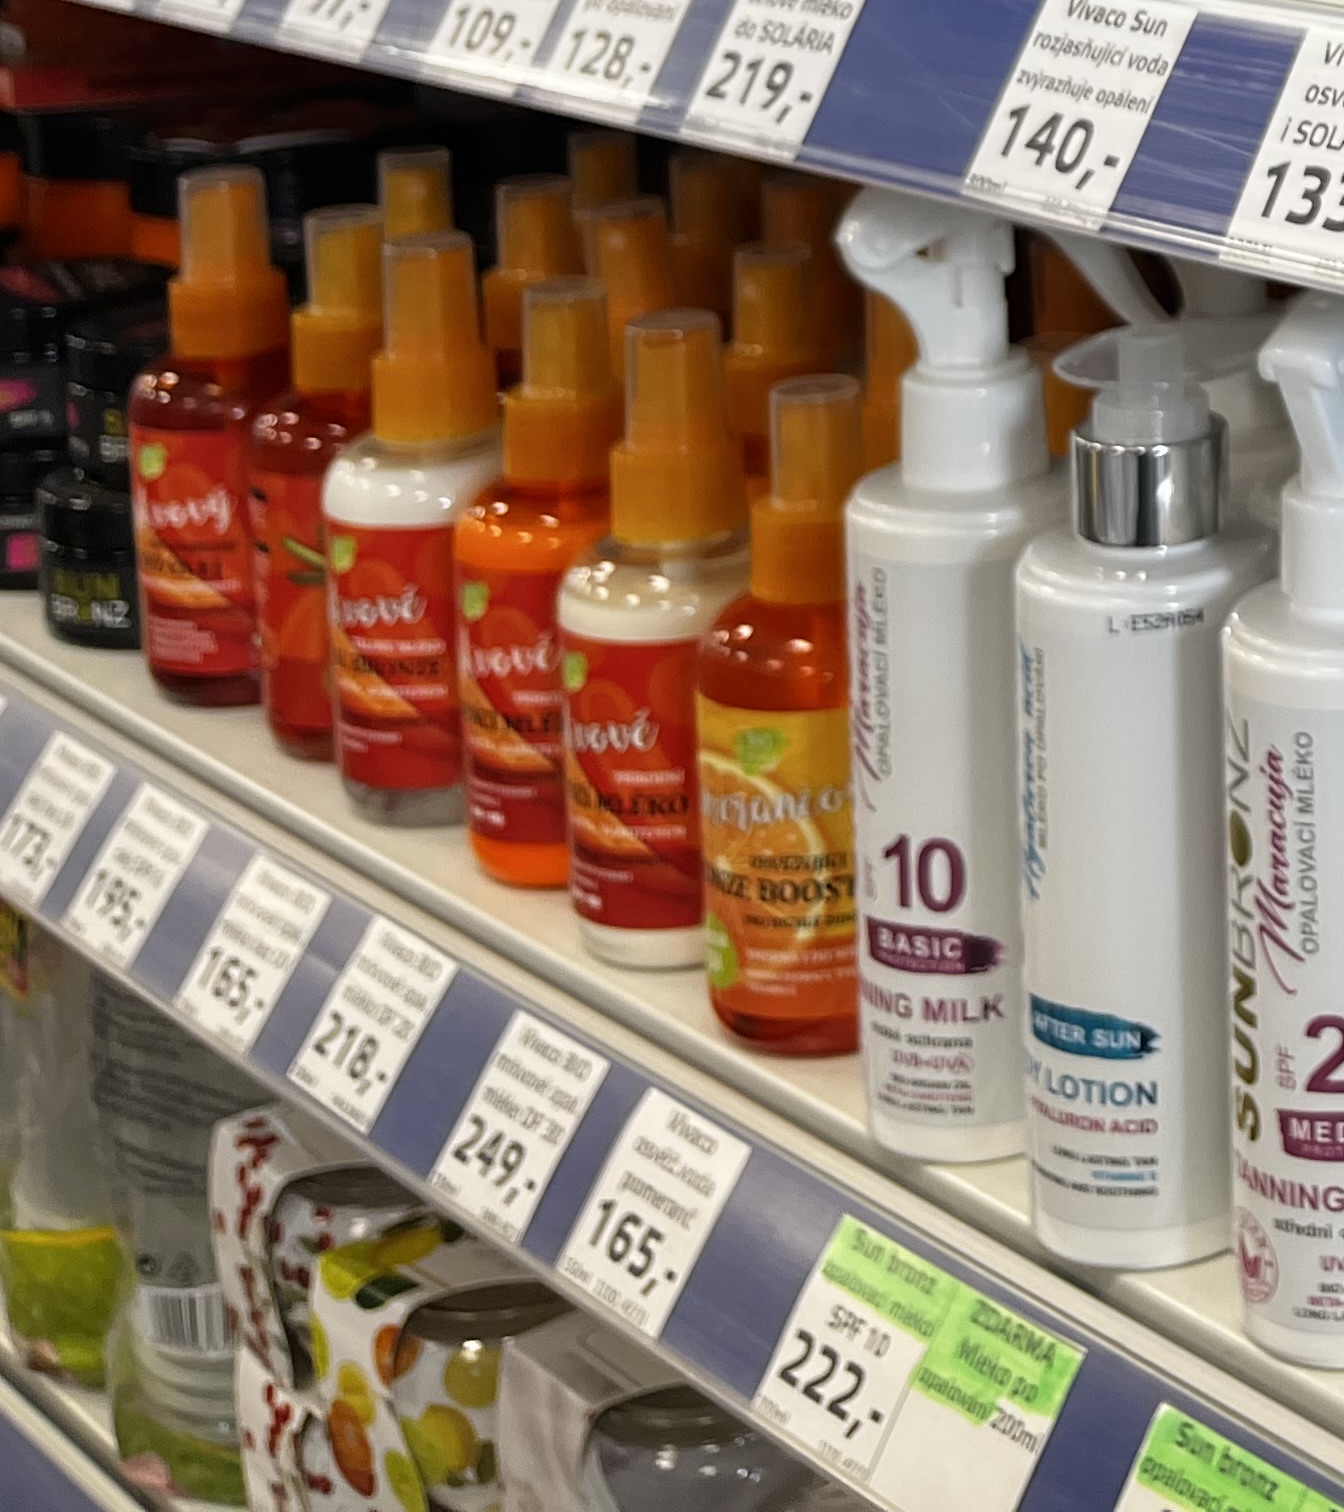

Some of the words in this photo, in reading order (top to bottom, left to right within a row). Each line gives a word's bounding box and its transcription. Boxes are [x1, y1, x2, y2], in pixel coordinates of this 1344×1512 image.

[565, 28, 652, 87] 128,-
[1032, 31, 1126, 67] rozjasňující
[1128, 53, 1171, 78] voda
[1133, 9, 1168, 38] Sun
[705, 51, 813, 126] 219,-
[1015, 68, 1095, 102] zvýrazňuje
[1095, 85, 1154, 114] opálení
[1000, 105, 1121, 190] 140,-
[882, 832, 967, 914] 10
[876, 926, 964, 961] BASIC
[313, 1009, 387, 1097] 218,-
[1045, 1079, 1159, 1107] LOTION
[451, 1112, 537, 1206] 249,-
[588, 1197, 678, 1297] 165,-
[776, 1329, 884, 1442] 222,-
